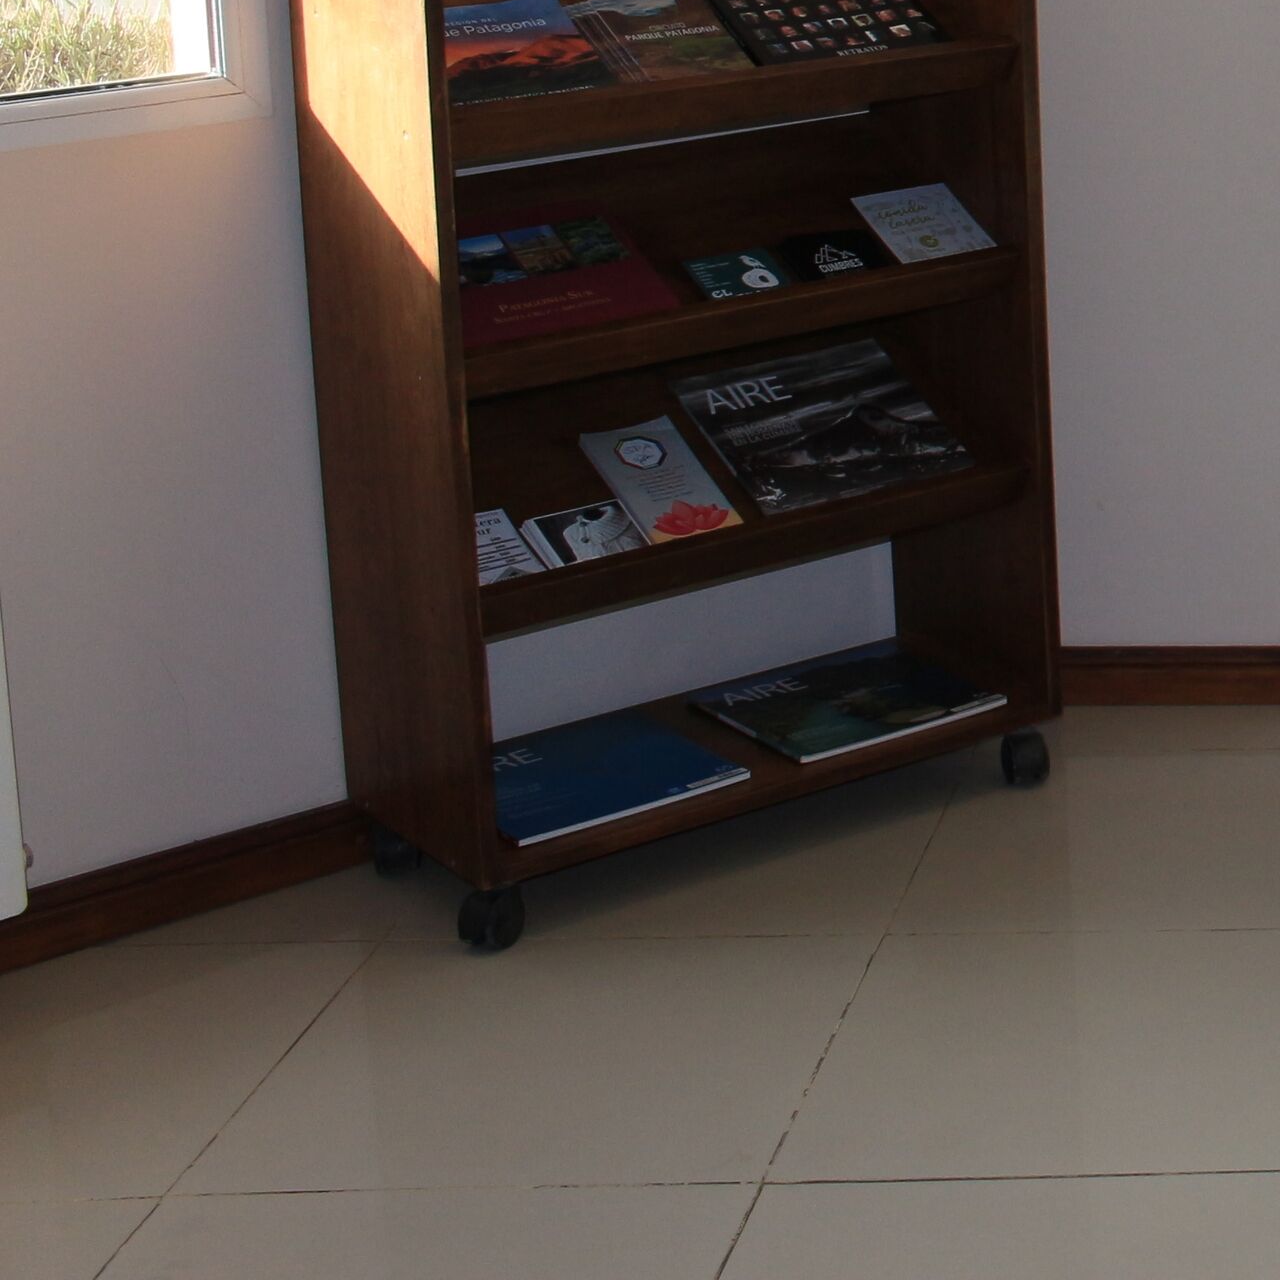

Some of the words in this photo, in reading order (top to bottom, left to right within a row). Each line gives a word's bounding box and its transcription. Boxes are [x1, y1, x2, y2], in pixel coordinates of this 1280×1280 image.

[464, 18, 547, 35] Patagonia
[624, 31, 665, 41] PARQUE
[665, 24, 720, 39] PATAGONIA
[836, 44, 889, 57] RETRATOS
[819, 258, 864, 273] CUMBRES
[706, 376, 794, 416] AIRE
[723, 676, 809, 707] AIRE
